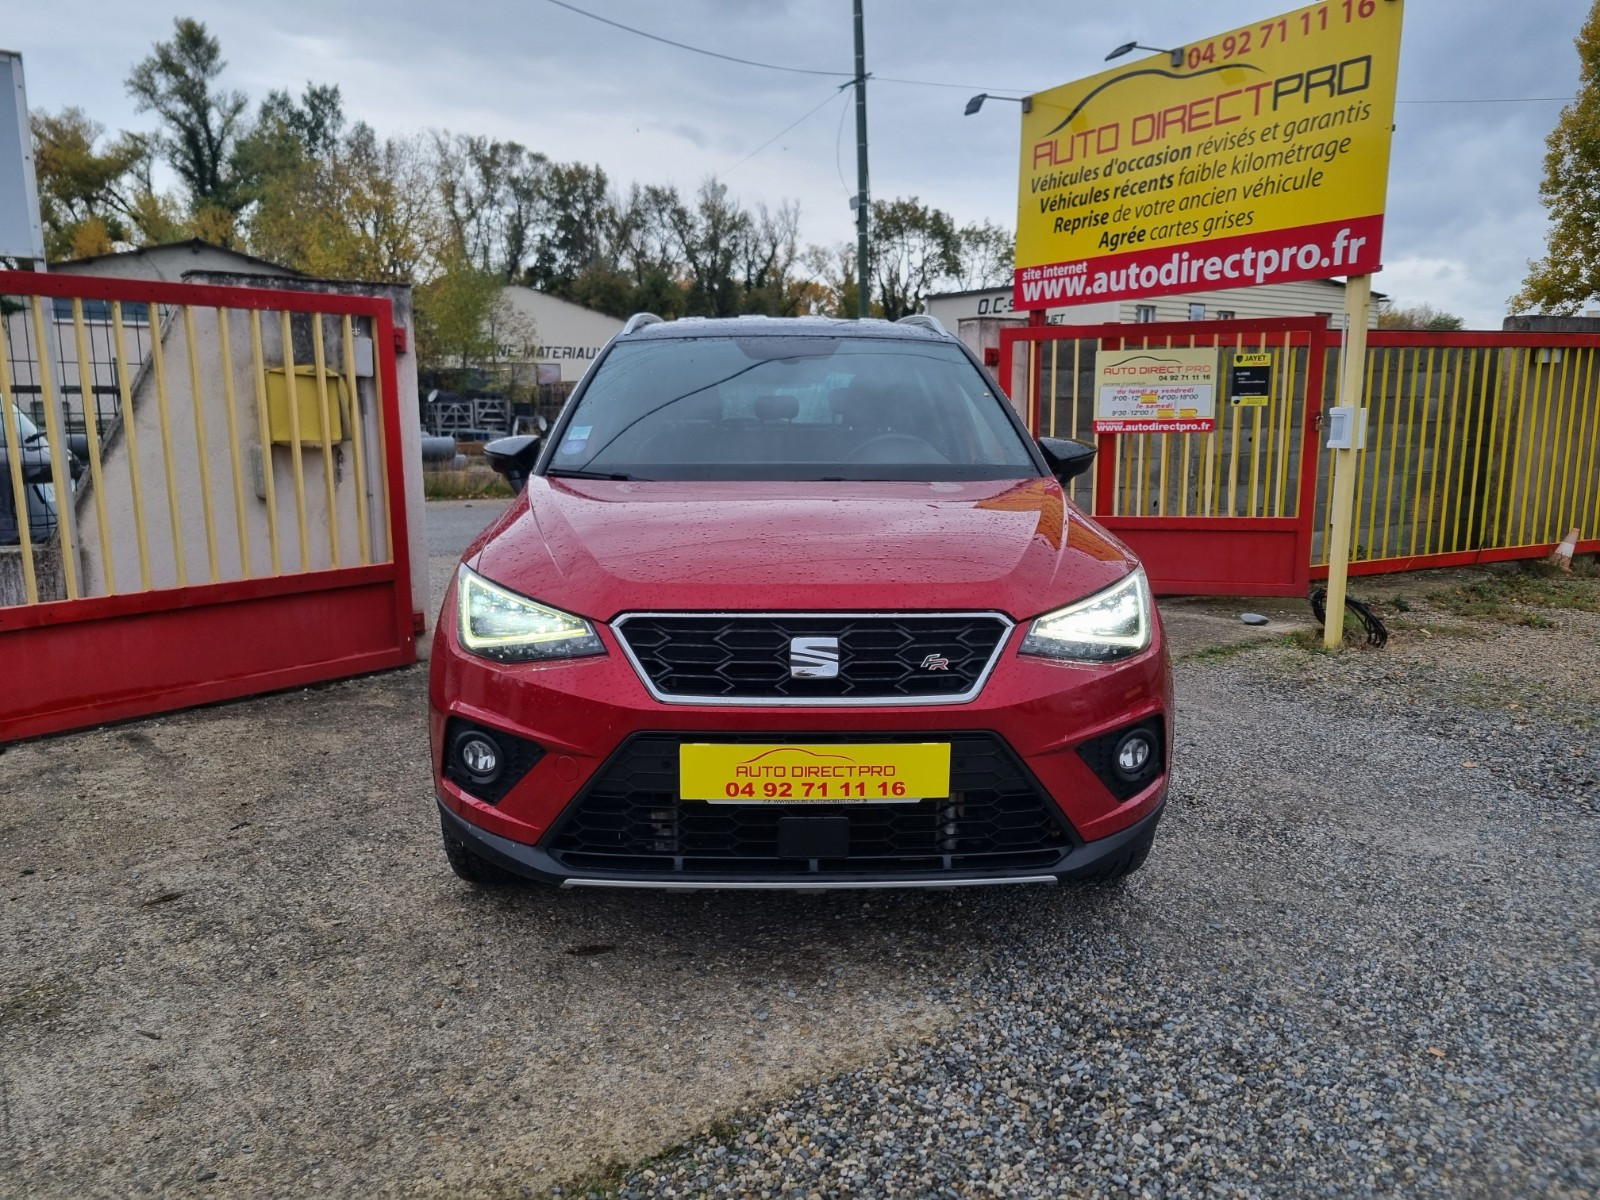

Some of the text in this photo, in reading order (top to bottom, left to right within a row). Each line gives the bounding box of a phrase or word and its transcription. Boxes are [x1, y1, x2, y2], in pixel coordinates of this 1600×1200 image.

[1188, 0, 1376, 69] 04 92 71 11 16
[1031, 100, 1372, 194] Véhicules d'occasion révisés et garantis
[1033, 122, 1119, 171] AUTO
[1040, 136, 1352, 214] Véhicules récents faible kilométrage
[1053, 167, 1323, 235] Reprise de votre ancien véhicule
[1098, 209, 1255, 251] Agrée cartes grises
[1022, 228, 1366, 302] www.autodirectpro.fr
[1022, 261, 1088, 280] site internet
[1103, 367, 1136, 375] AUTO
[1096, 421, 1210, 432] www.autodirectpro.fr
[920, 653, 949, 671] FR
[725, 781, 906, 797] 04 92 71 11 16
[736, 765, 786, 777] AUTO
